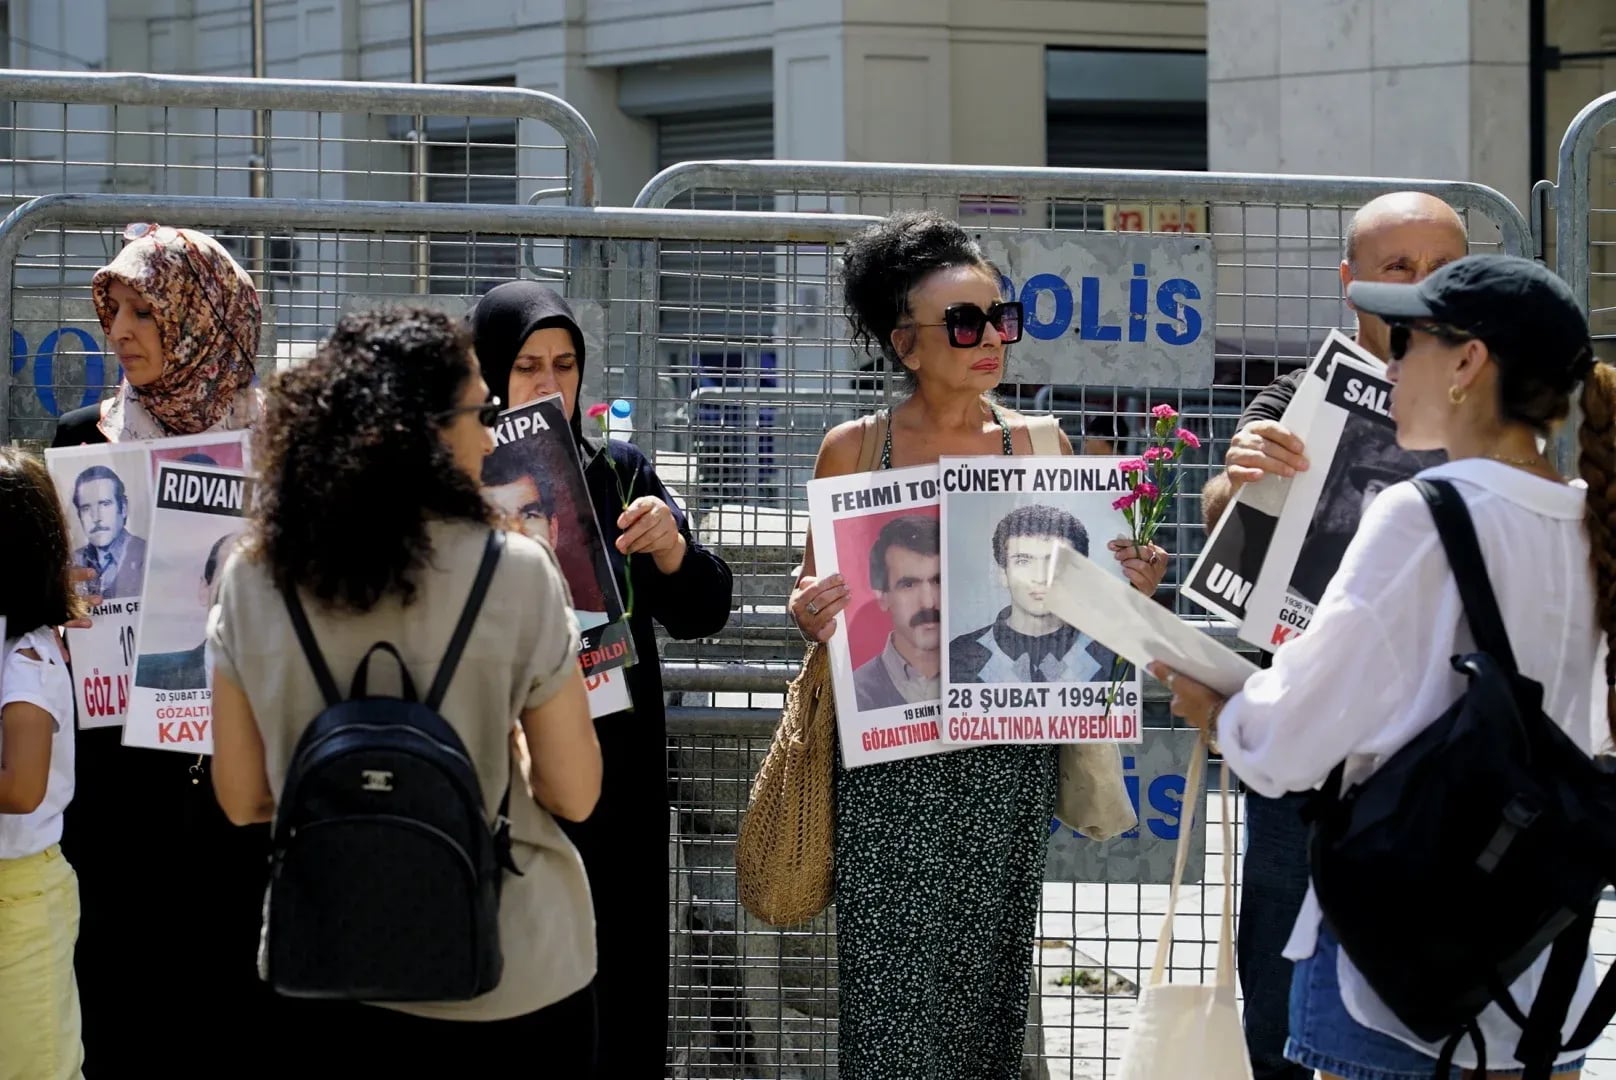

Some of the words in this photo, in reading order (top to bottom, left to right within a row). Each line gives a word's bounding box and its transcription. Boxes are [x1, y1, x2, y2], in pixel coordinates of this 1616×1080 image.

[1343, 378, 1394, 418] SAL
[163, 472, 244, 510] RIDVAN
[943, 464, 1027, 492] CÜNEYT
[831, 481, 901, 513] FEHMİ
[88, 603, 122, 617] AHİM
[1270, 623, 1301, 646] K
[84, 668, 115, 717] GÖZ
[155, 692, 167, 702] 20
[168, 691, 198, 703] ŞUBAT
[948, 688, 972, 709] 28
[980, 687, 1050, 713] ŞUBAT
[904, 709, 914, 720] 19
[915, 704, 935, 719] EKİM
[949, 711, 1044, 740] GÖZALTINDA
[1048, 709, 1137, 739] KAYBEDİLDİ
[159, 720, 208, 744] KAY
[862, 720, 940, 752] GÖZALTINDA
